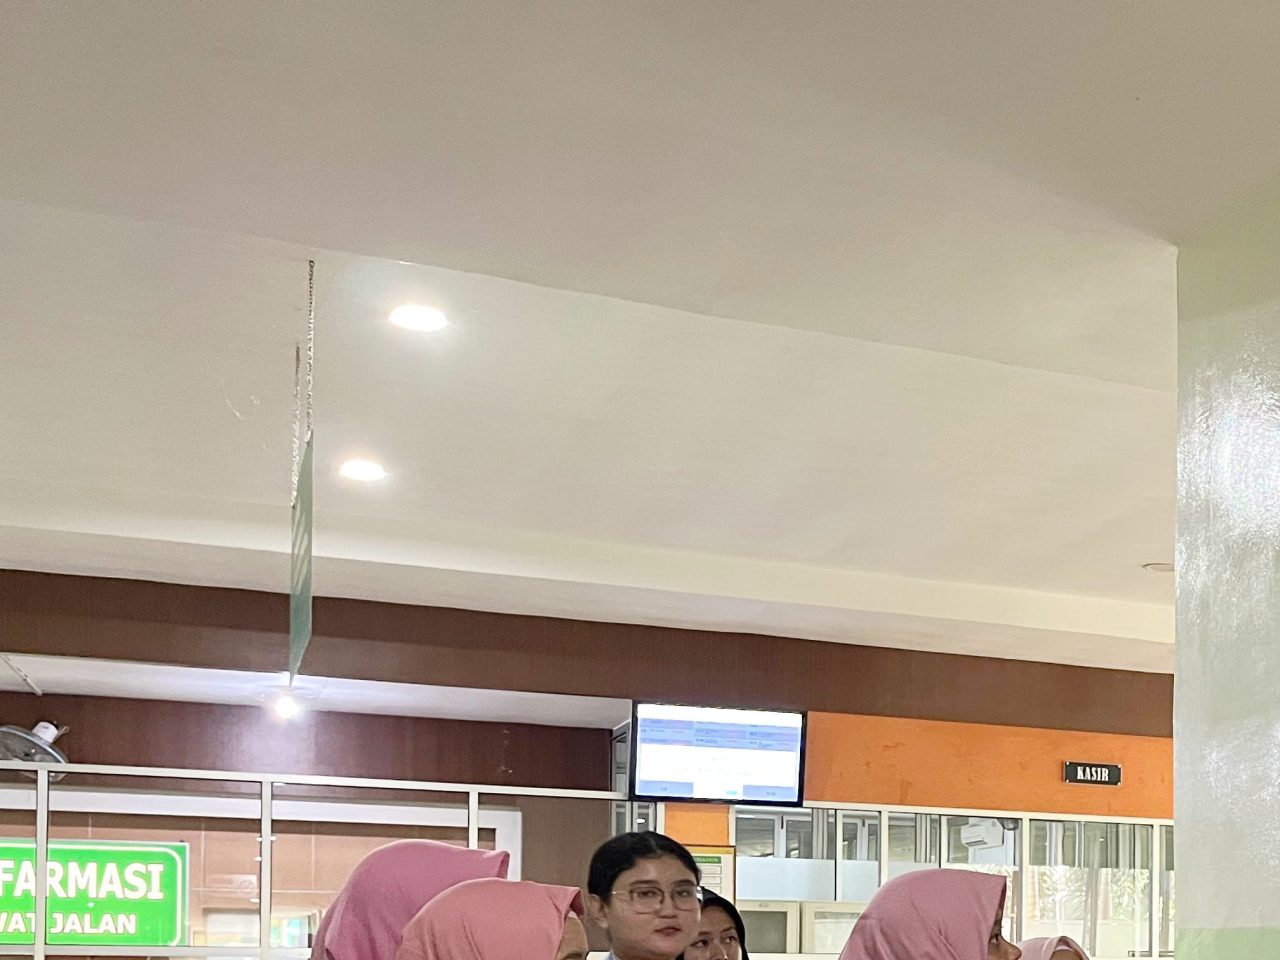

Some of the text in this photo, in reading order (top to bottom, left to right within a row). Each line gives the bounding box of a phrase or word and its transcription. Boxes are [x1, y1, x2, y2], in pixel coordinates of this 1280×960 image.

[1076, 766, 1109, 781] KASIR
[0, 859, 164, 900] FARMASI
[50, 912, 136, 934] JALAN
